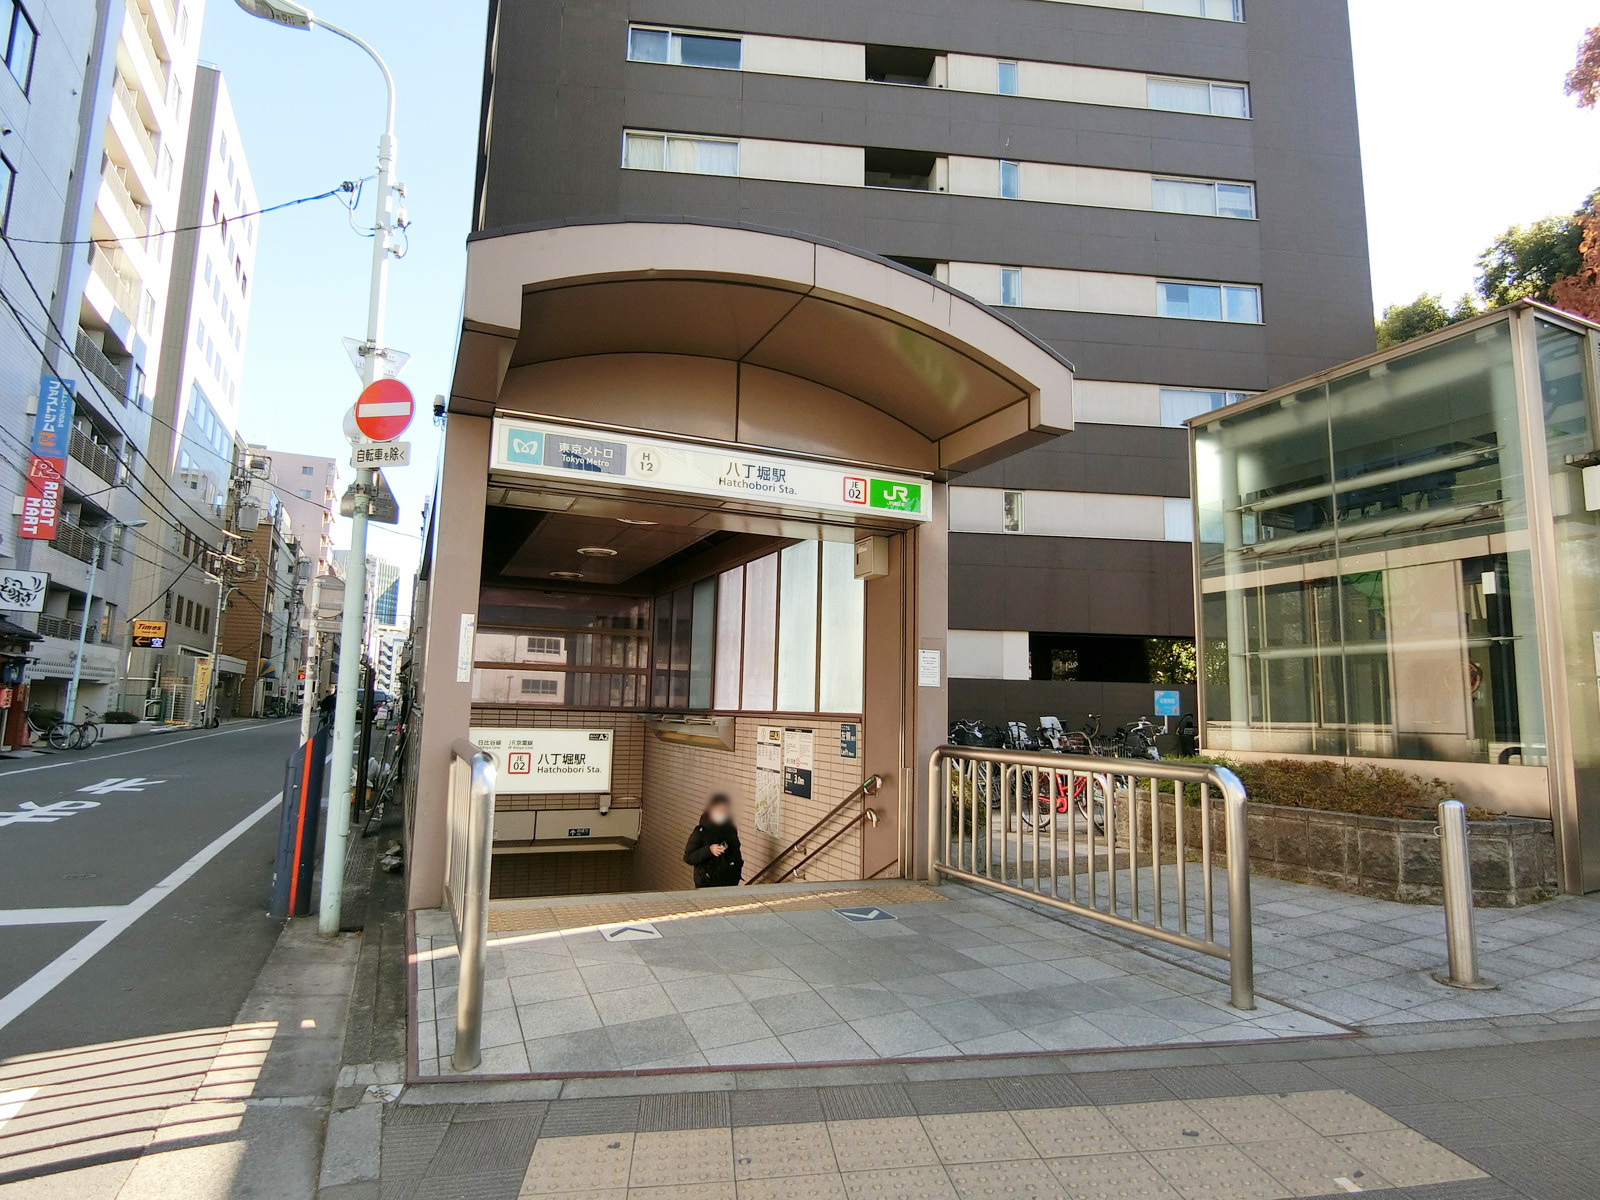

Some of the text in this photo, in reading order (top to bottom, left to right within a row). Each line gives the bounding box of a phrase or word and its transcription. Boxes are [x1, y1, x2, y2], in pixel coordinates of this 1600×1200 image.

[356, 447, 405, 463] 自転車を除く
[559, 442, 614, 459] 東京メトロ
[642, 452, 650, 461] H
[562, 454, 610, 468] Tokyo Metro
[639, 461, 653, 472] 12
[726, 461, 786, 483] 八丁堀駅
[718, 476, 797, 495] Hatchobori Sta.
[851, 481, 859, 489] JE
[848, 488, 861, 500] 02
[883, 485, 909, 503] JR
[39, 481, 59, 527] ROBOT
[23, 497, 41, 535] MART
[137, 623, 162, 632] Times
[513, 761, 526, 771] 02
[538, 753, 586, 766] 八丁堀駅
[537, 765, 602, 774] Hatchobori Sta.
